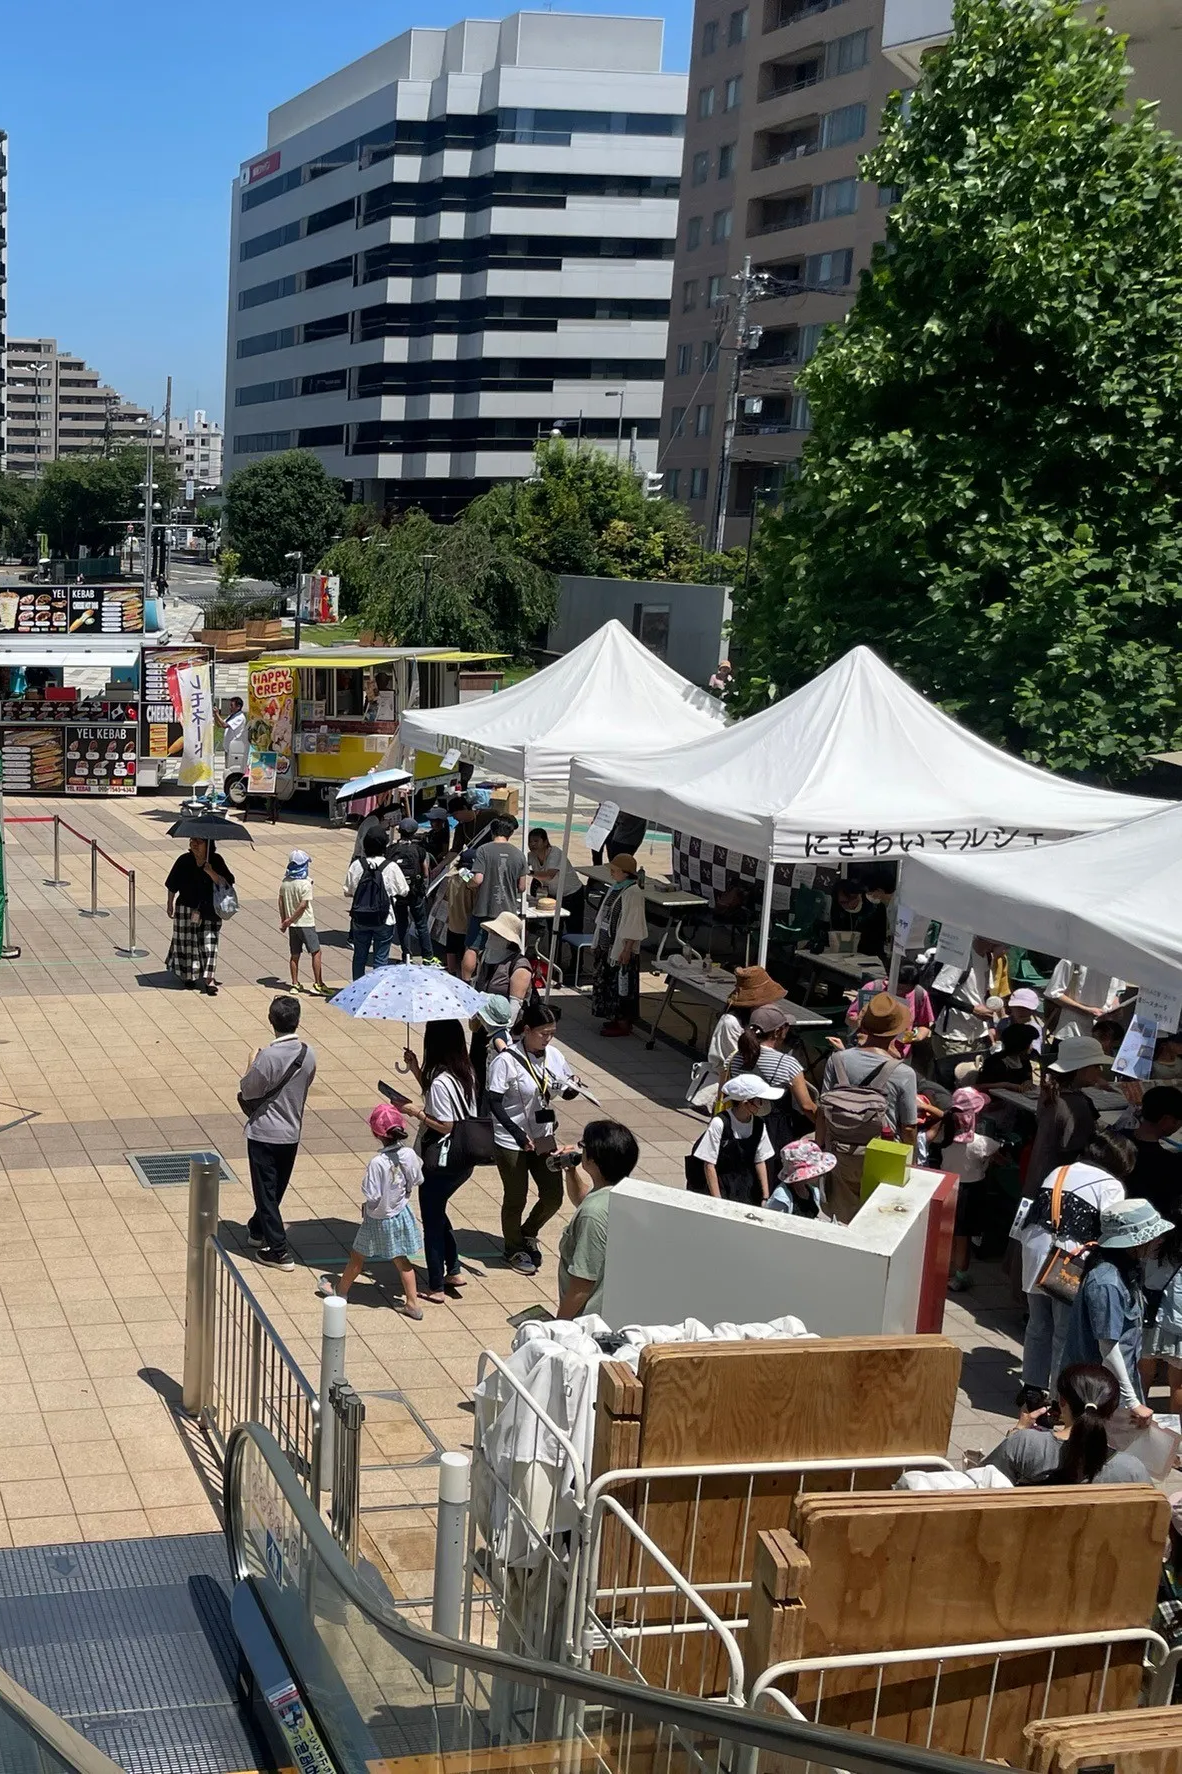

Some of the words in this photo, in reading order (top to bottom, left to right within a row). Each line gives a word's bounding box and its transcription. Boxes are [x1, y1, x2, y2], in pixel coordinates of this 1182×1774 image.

[52, 589, 66, 599] YEL
[72, 589, 95, 599] KEBAB
[252, 669, 289, 685] HAPPY
[256, 680, 292, 696] CREPE
[146, 704, 174, 723] CHEESE
[76, 728, 94, 739] YEL
[96, 728, 127, 740] KEBAB
[804, 827, 1044, 858] にぎわいマルシェ
